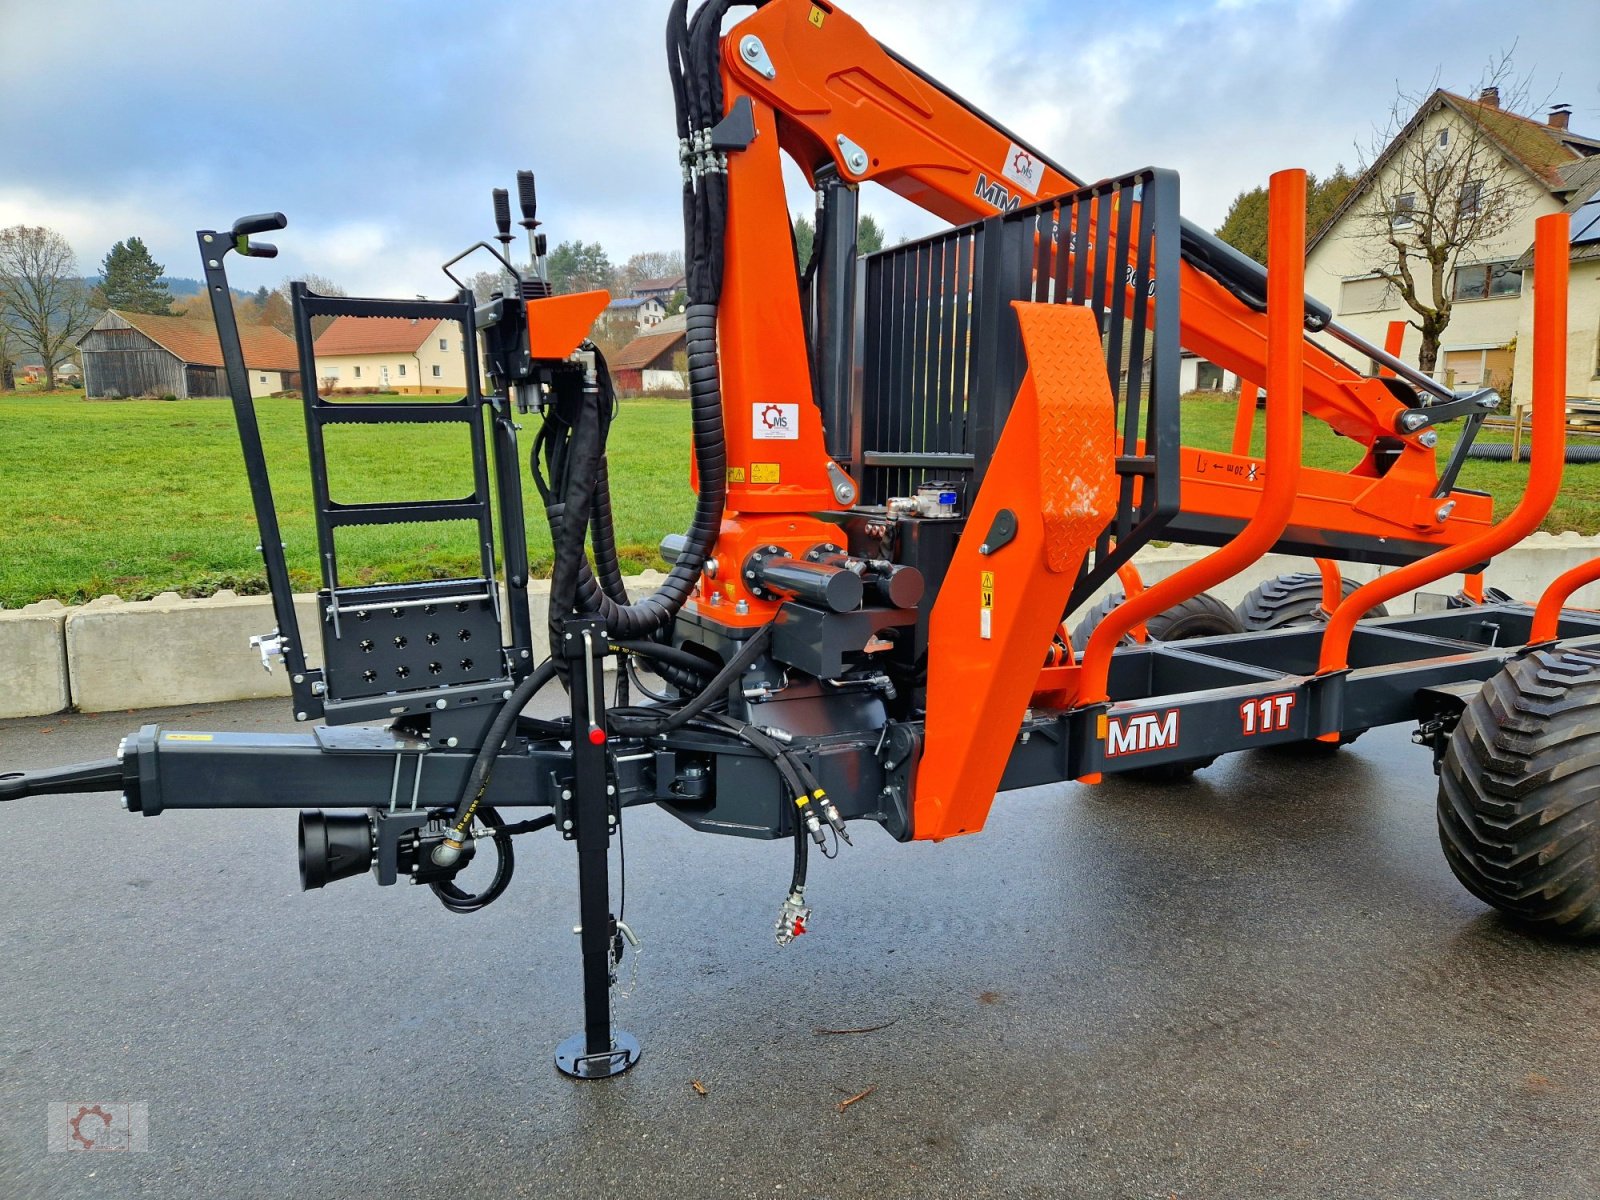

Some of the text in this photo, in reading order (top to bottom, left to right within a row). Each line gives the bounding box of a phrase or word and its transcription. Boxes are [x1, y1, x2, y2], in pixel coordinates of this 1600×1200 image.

[974, 172, 1021, 213] MTM
[1106, 709, 1179, 757] MTM
[1240, 693, 1295, 735] 11T
